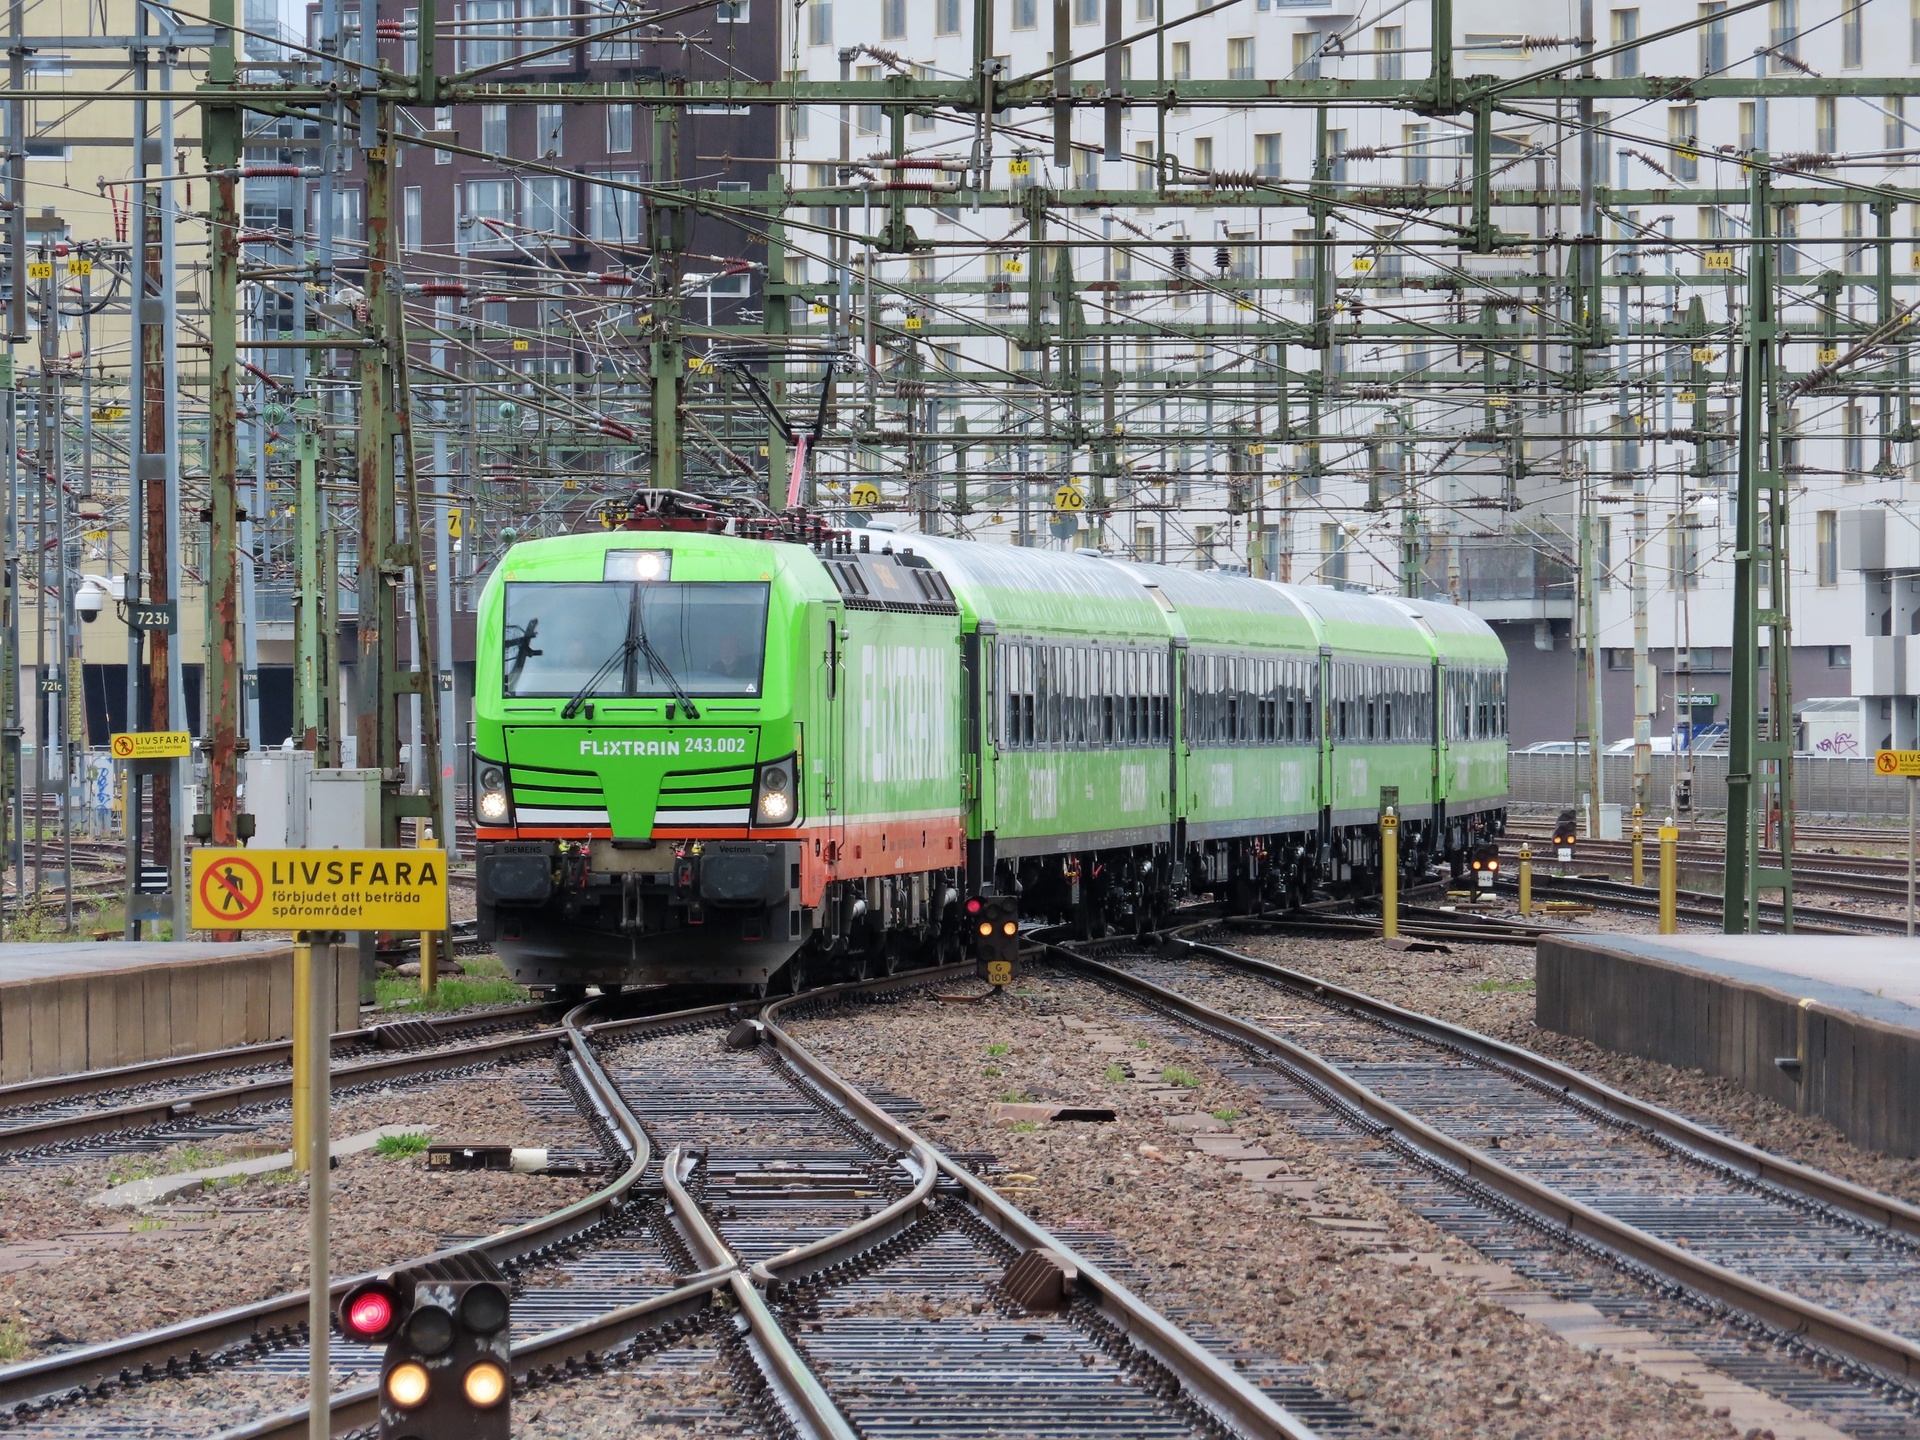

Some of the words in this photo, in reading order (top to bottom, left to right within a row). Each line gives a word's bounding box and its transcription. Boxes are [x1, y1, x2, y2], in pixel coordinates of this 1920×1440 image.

[1010, 164, 1027, 173] A44
[1708, 256, 1729, 267] A44
[31, 267, 50, 276] A45
[70, 264, 89, 273] A42
[1006, 264, 1021, 272] A44
[854, 491, 877, 505] 70
[1058, 492, 1081, 507] 70
[137, 612, 169, 625] 723b
[42, 682, 62, 691] 721c
[136, 736, 187, 745] LIVSFARA
[685, 738, 745, 753] 243.002
[504, 846, 542, 854] SIEMENS
[272, 861, 438, 885] LIVSFARA
[272, 891, 337, 903] förbjudet
[342, 892, 360, 902] att
[365, 891, 420, 903] beträda
[272, 905, 363, 918] spårområdet
[996, 963, 1002, 971] G
[991, 974, 1008, 982] 108
[435, 1155, 447, 1163] 195
